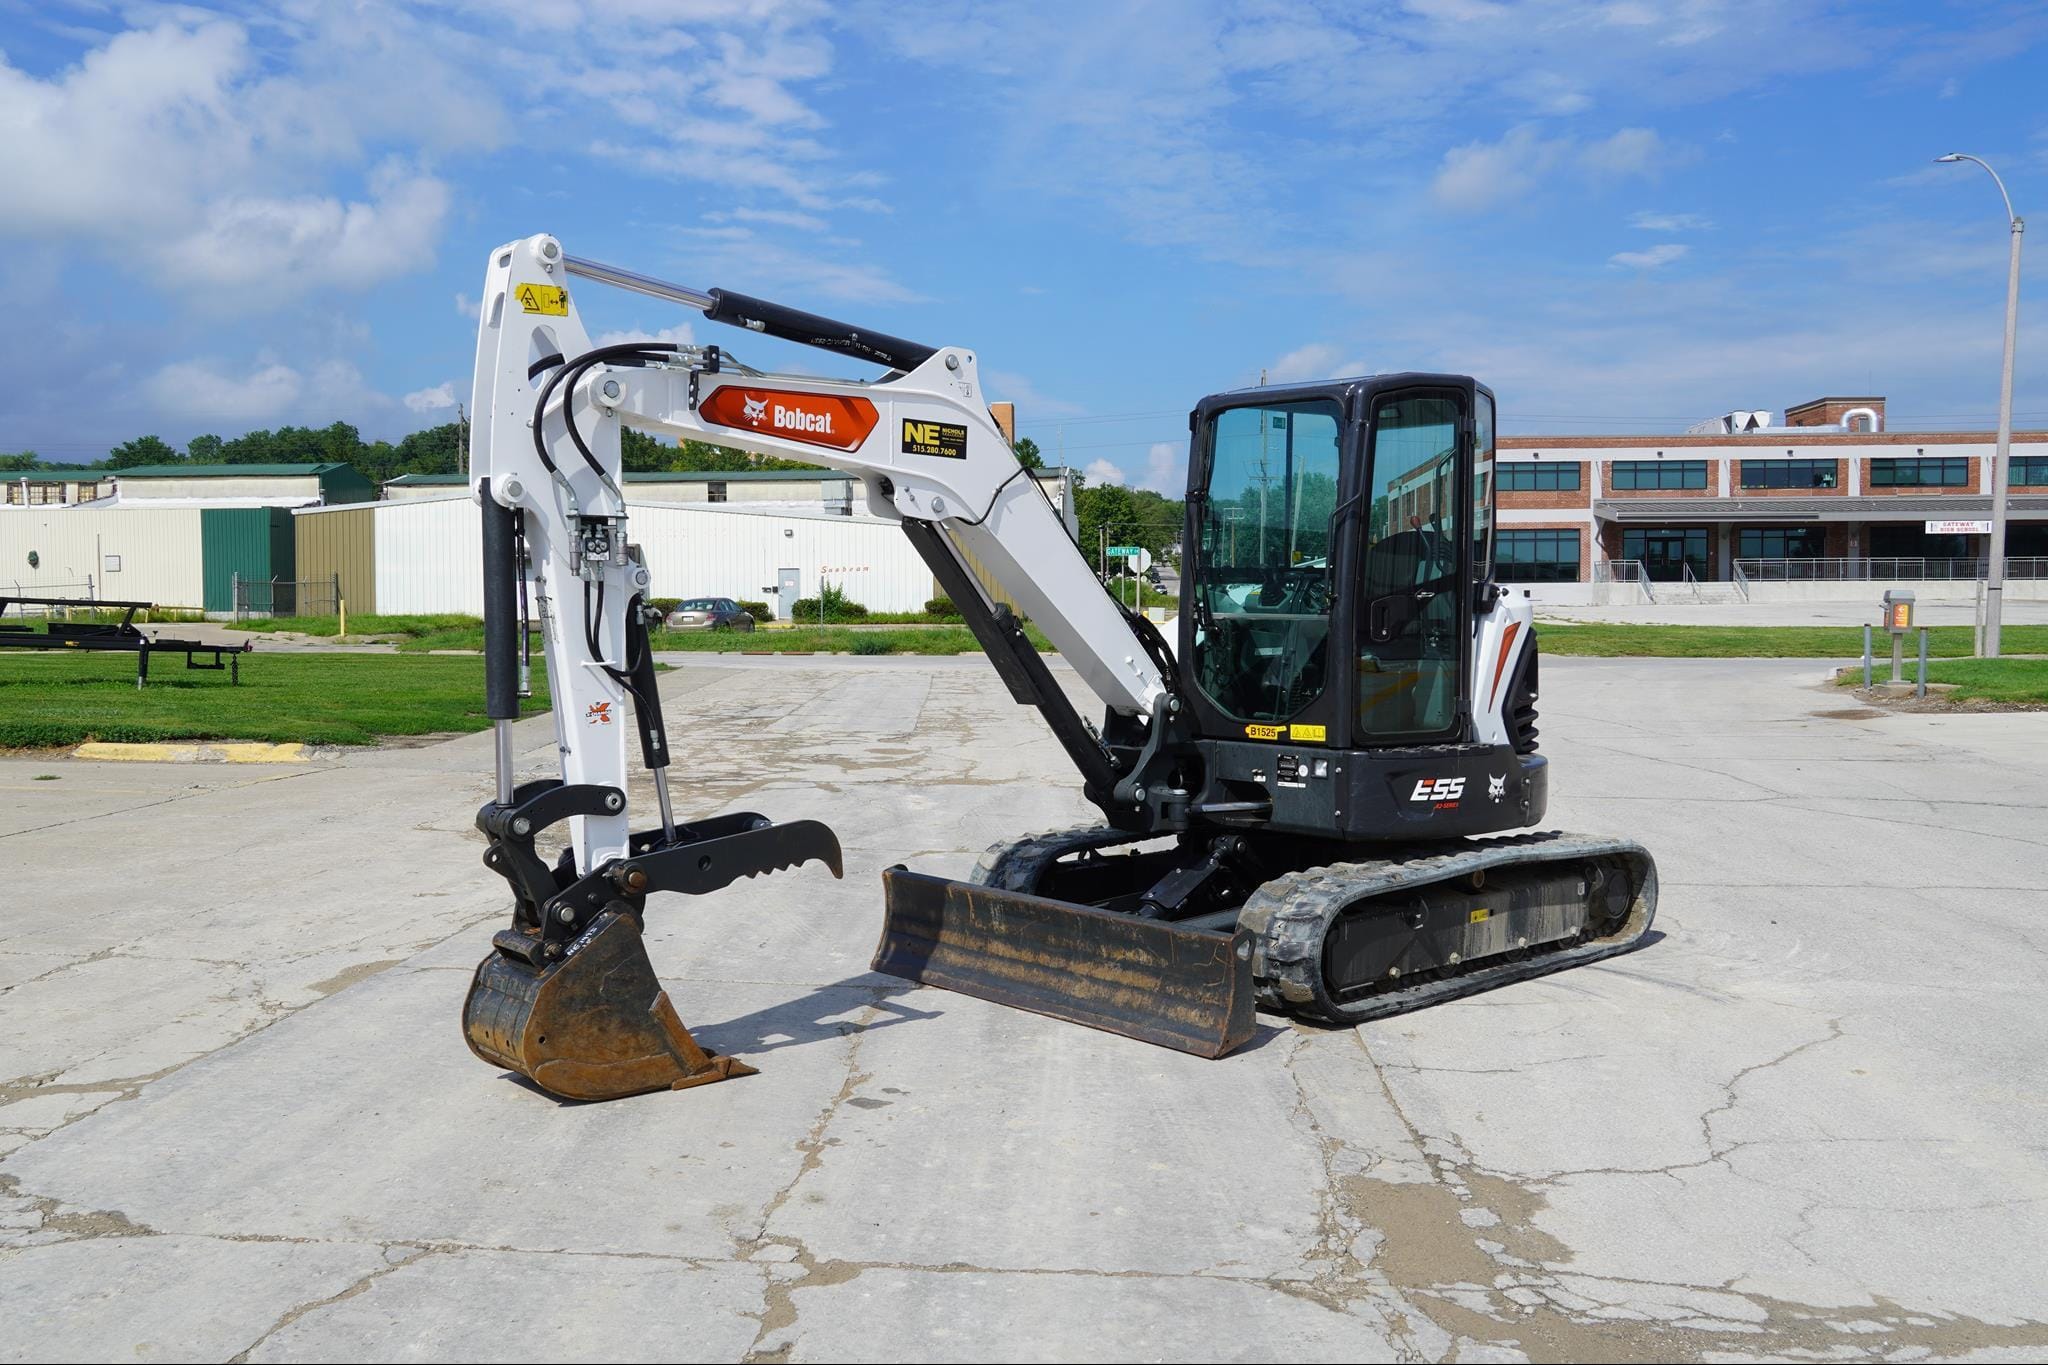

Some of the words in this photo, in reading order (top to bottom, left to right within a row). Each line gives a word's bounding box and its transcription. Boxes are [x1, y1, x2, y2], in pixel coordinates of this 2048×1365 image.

[774, 404, 832, 434] Bobcat
[904, 422, 940, 445] NE
[912, 444, 957, 456] 515.280.7600
[1250, 726, 1276, 738] B1525
